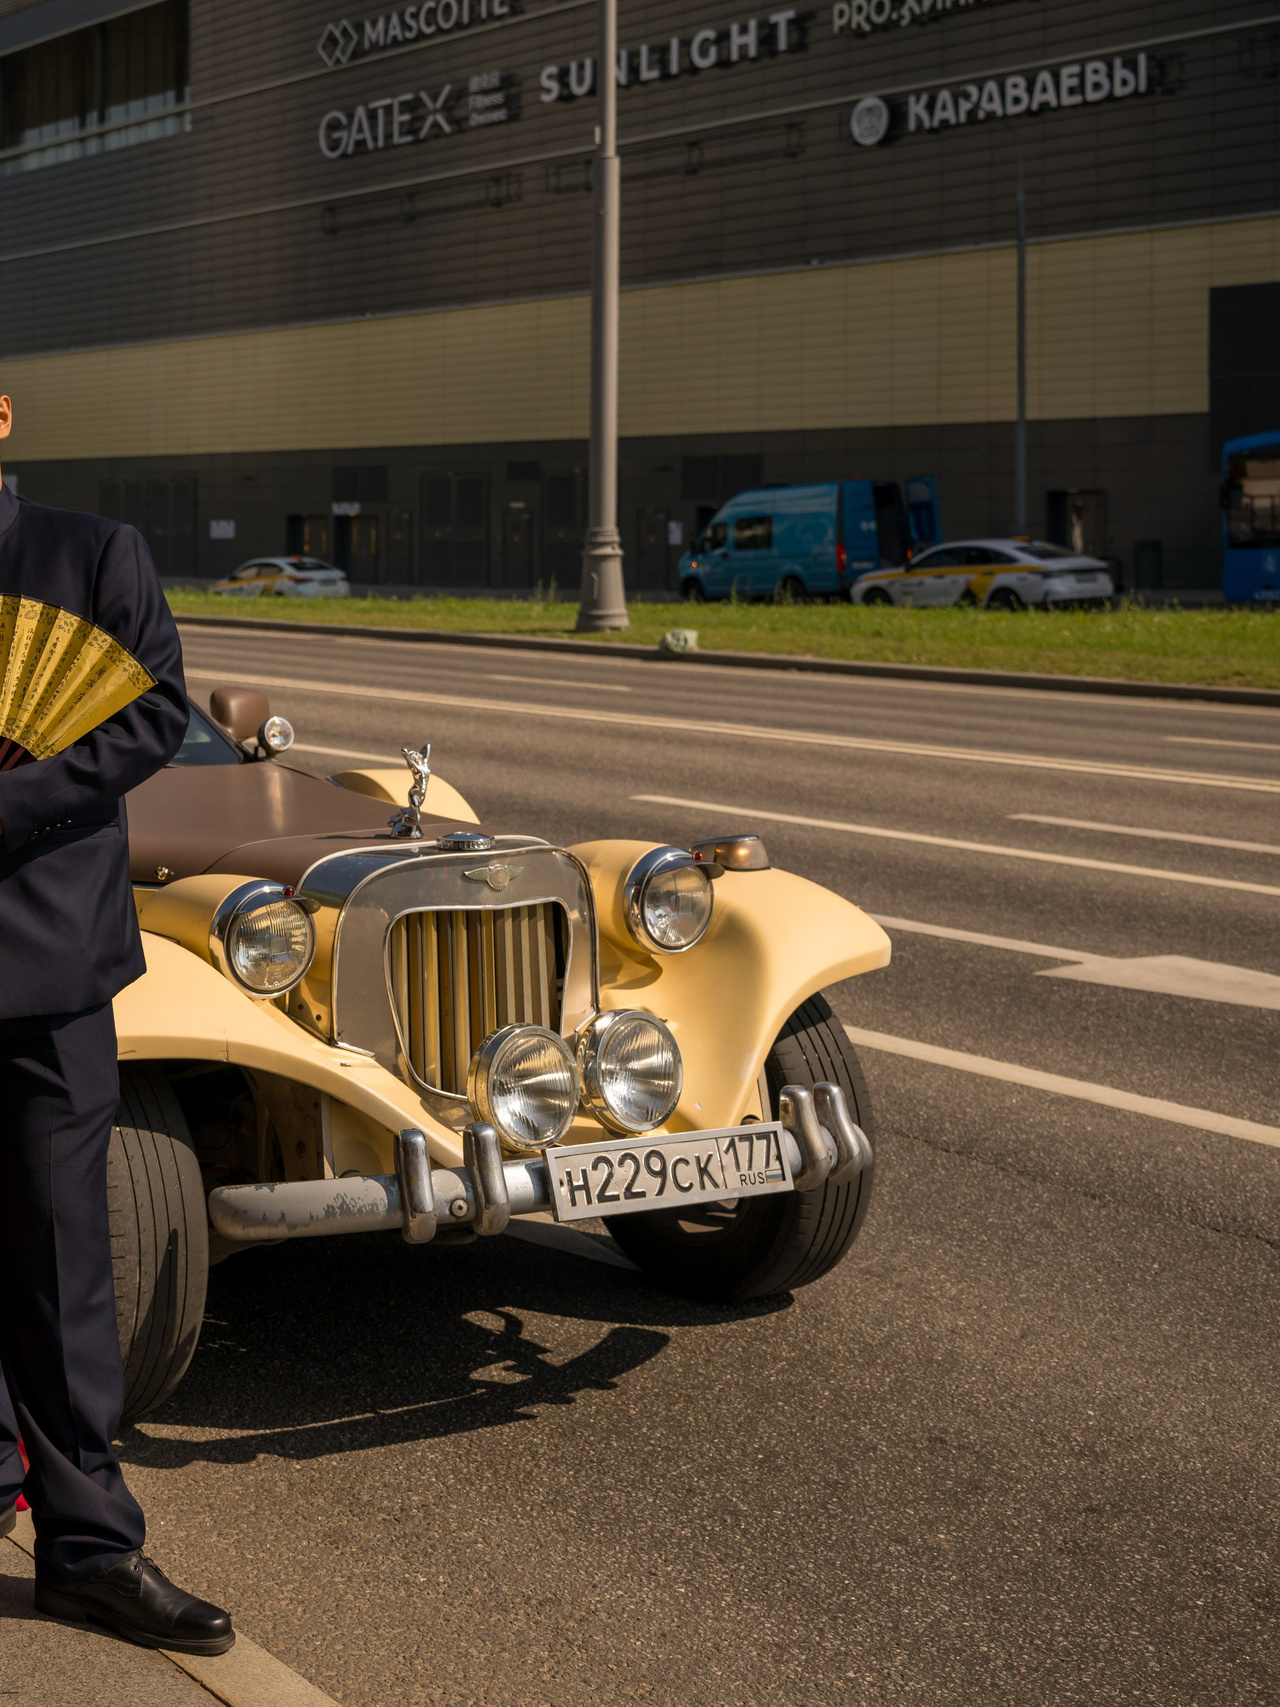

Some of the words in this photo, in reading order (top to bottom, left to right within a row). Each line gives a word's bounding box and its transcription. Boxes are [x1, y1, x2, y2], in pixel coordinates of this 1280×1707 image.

[908, 52, 1148, 132] КАРАВАЕВЫ
[723, 1132, 771, 1172] 177
[739, 1169, 766, 1186] RUS
